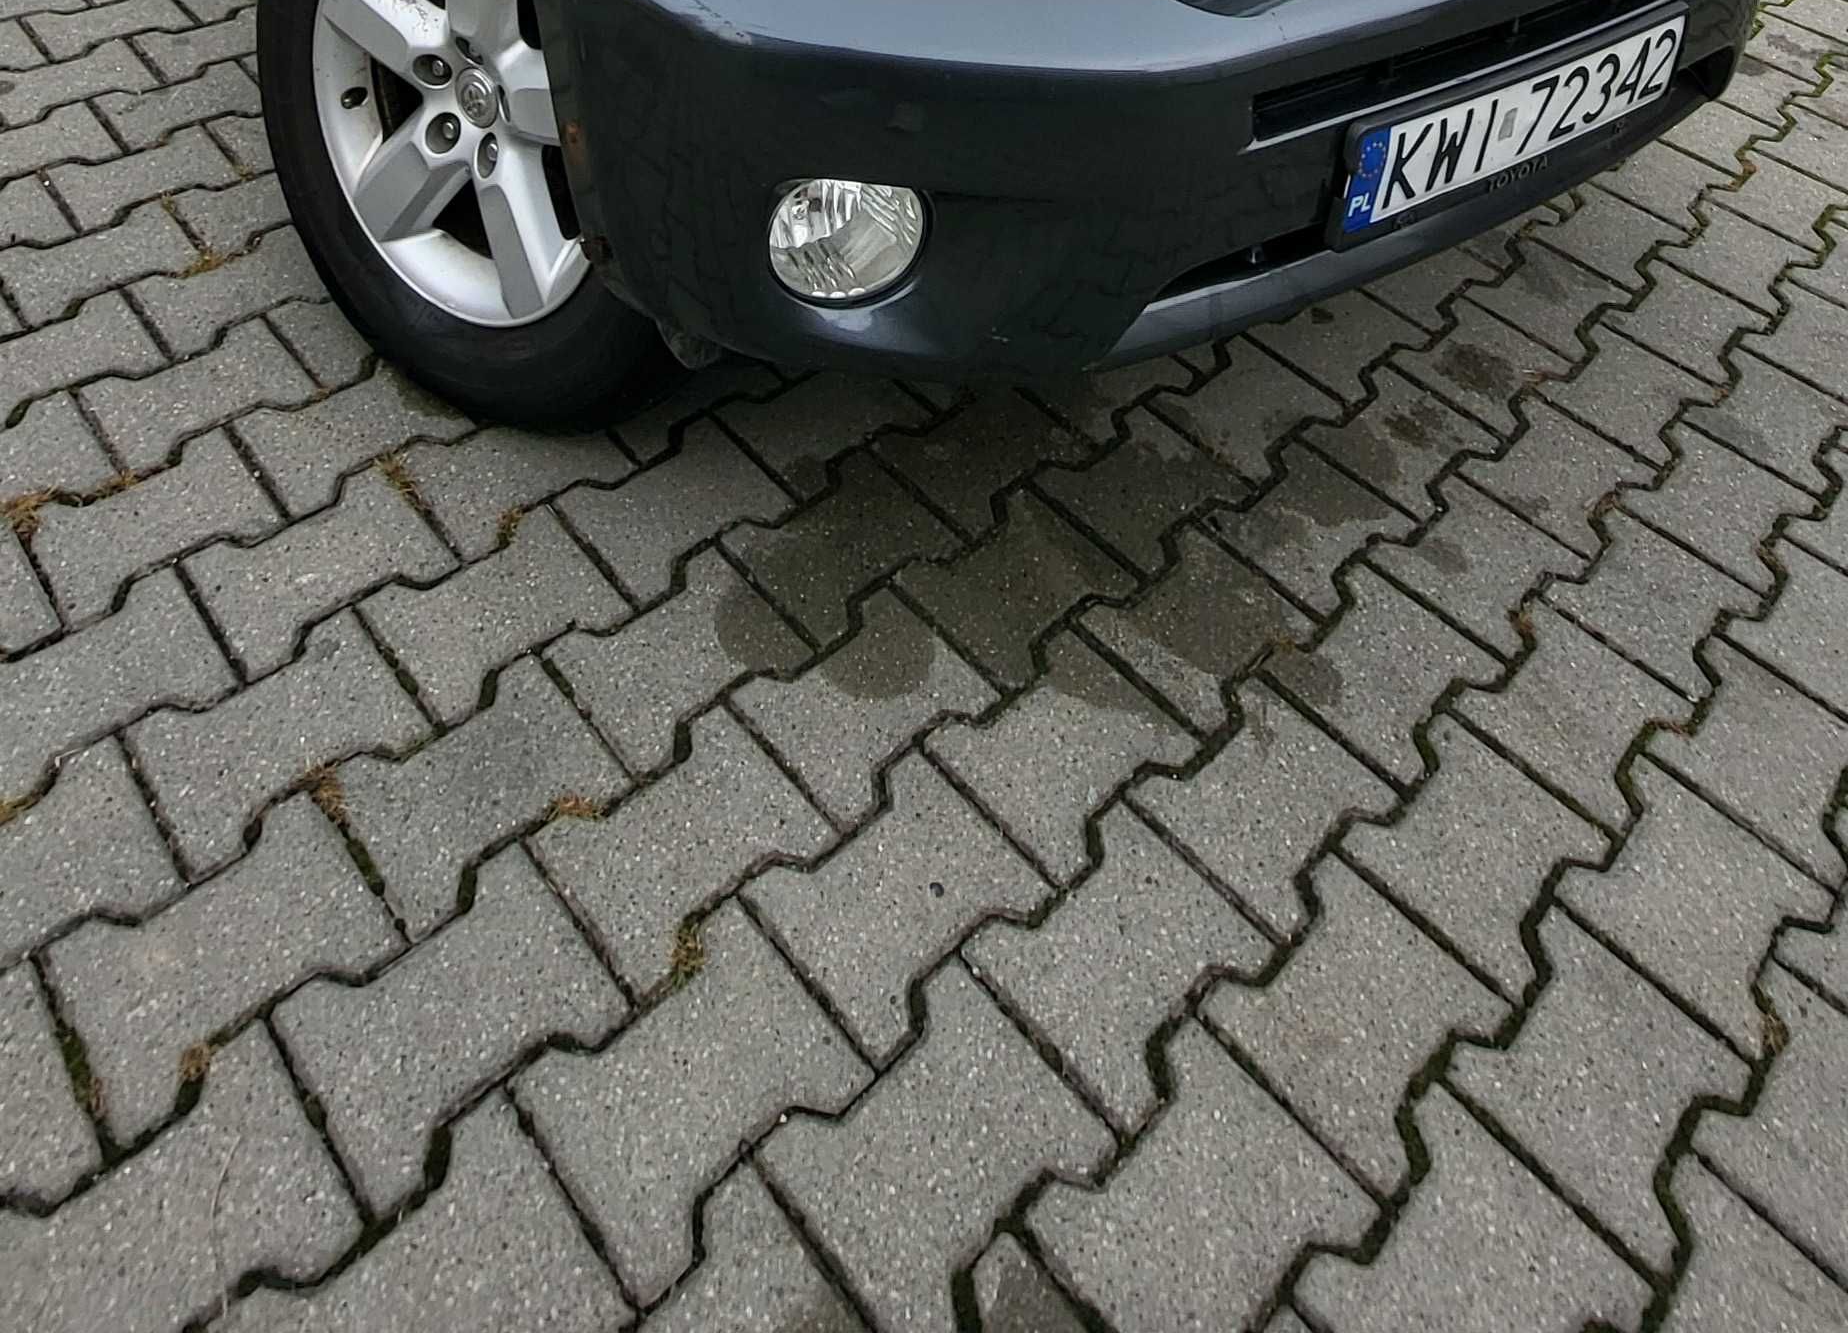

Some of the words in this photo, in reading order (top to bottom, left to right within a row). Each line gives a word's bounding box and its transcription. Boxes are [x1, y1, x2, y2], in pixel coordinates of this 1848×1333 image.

[1382, 98, 1499, 211] KWI
[1515, 28, 1677, 157] 72342
[1485, 155, 1549, 193] TOYOTA
[1347, 192, 1372, 218] PL
